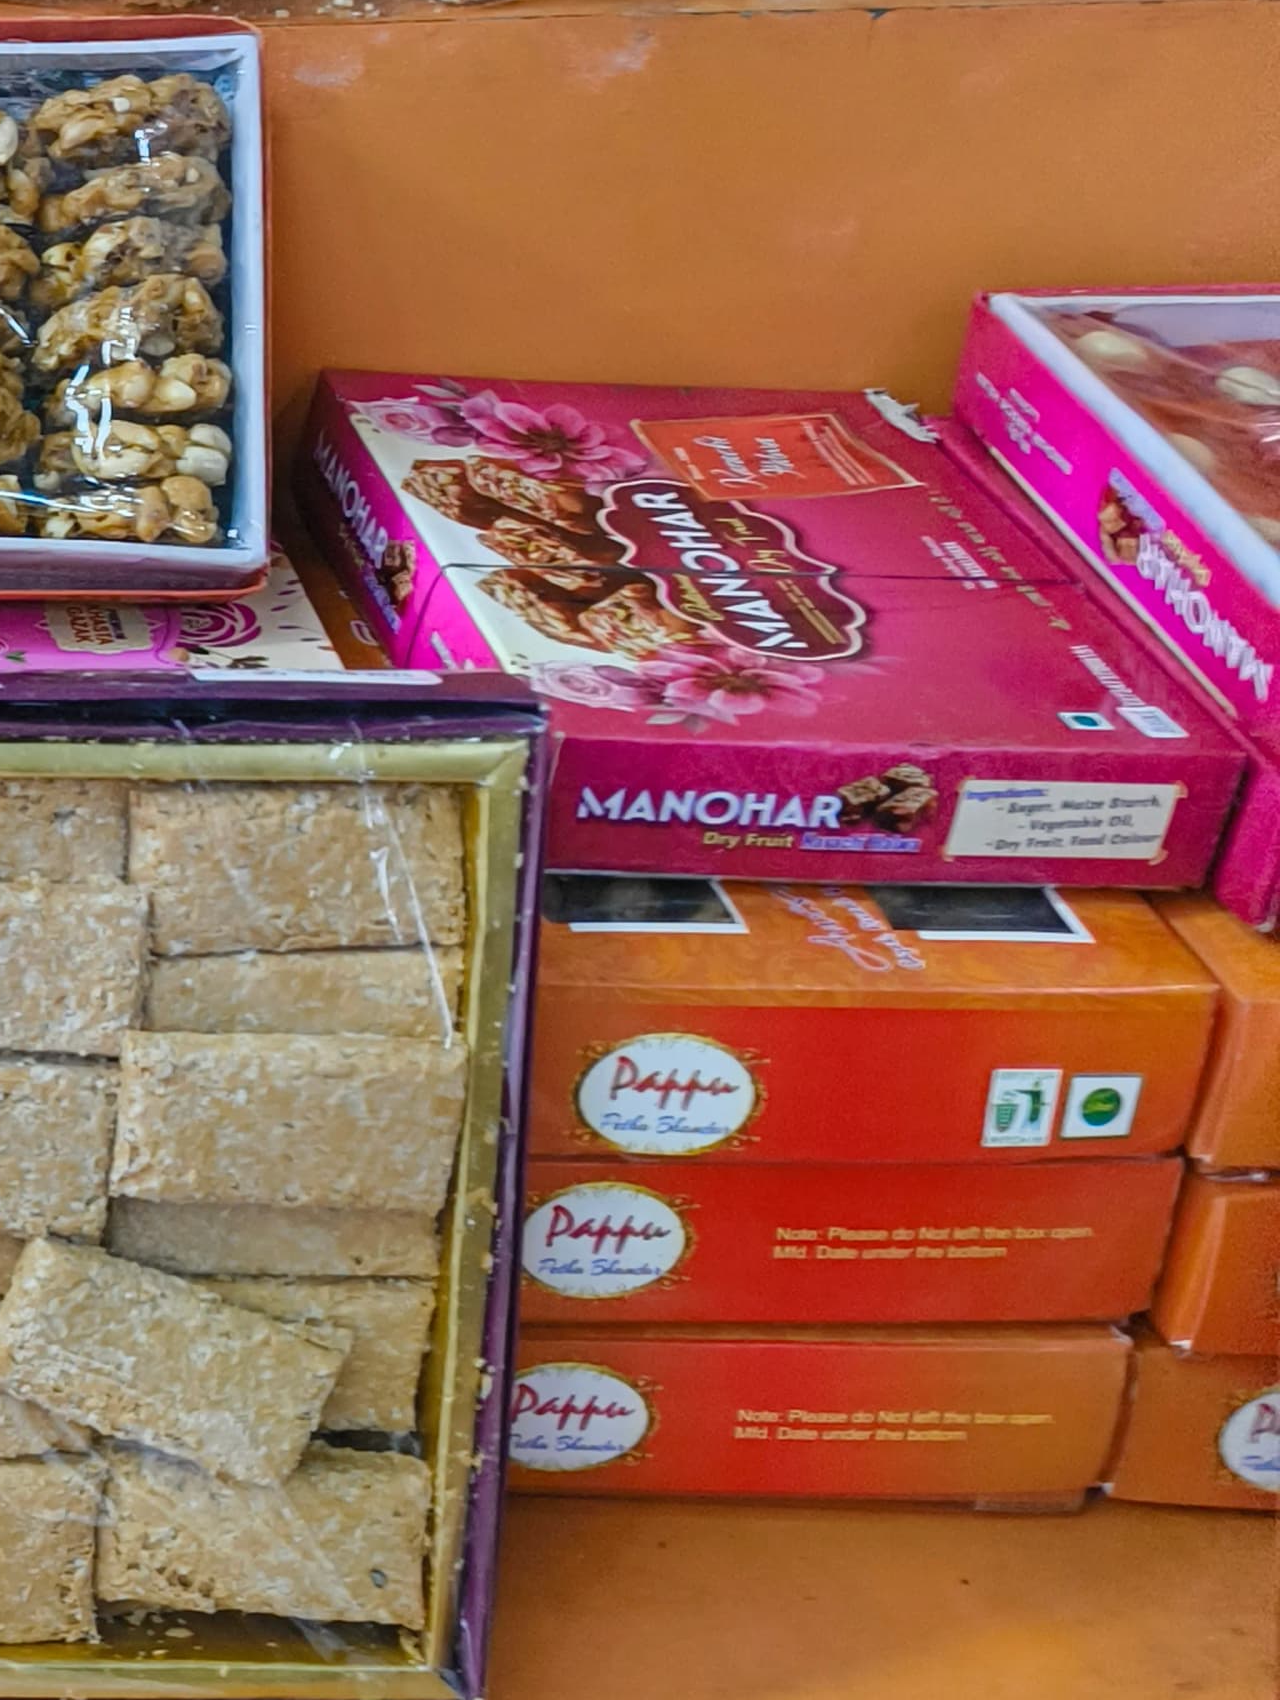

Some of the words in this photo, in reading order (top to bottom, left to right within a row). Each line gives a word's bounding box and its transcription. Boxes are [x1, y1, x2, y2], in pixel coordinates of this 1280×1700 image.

[631, 492, 808, 648] MANOHAR
[576, 787, 844, 828] MANOHAR
[702, 831, 740, 850] Dry
[744, 833, 794, 848] Fruit
[608, 1055, 741, 1112] Pappu
[545, 1204, 671, 1254] Pappu
[510, 1383, 637, 1431] Pappu
